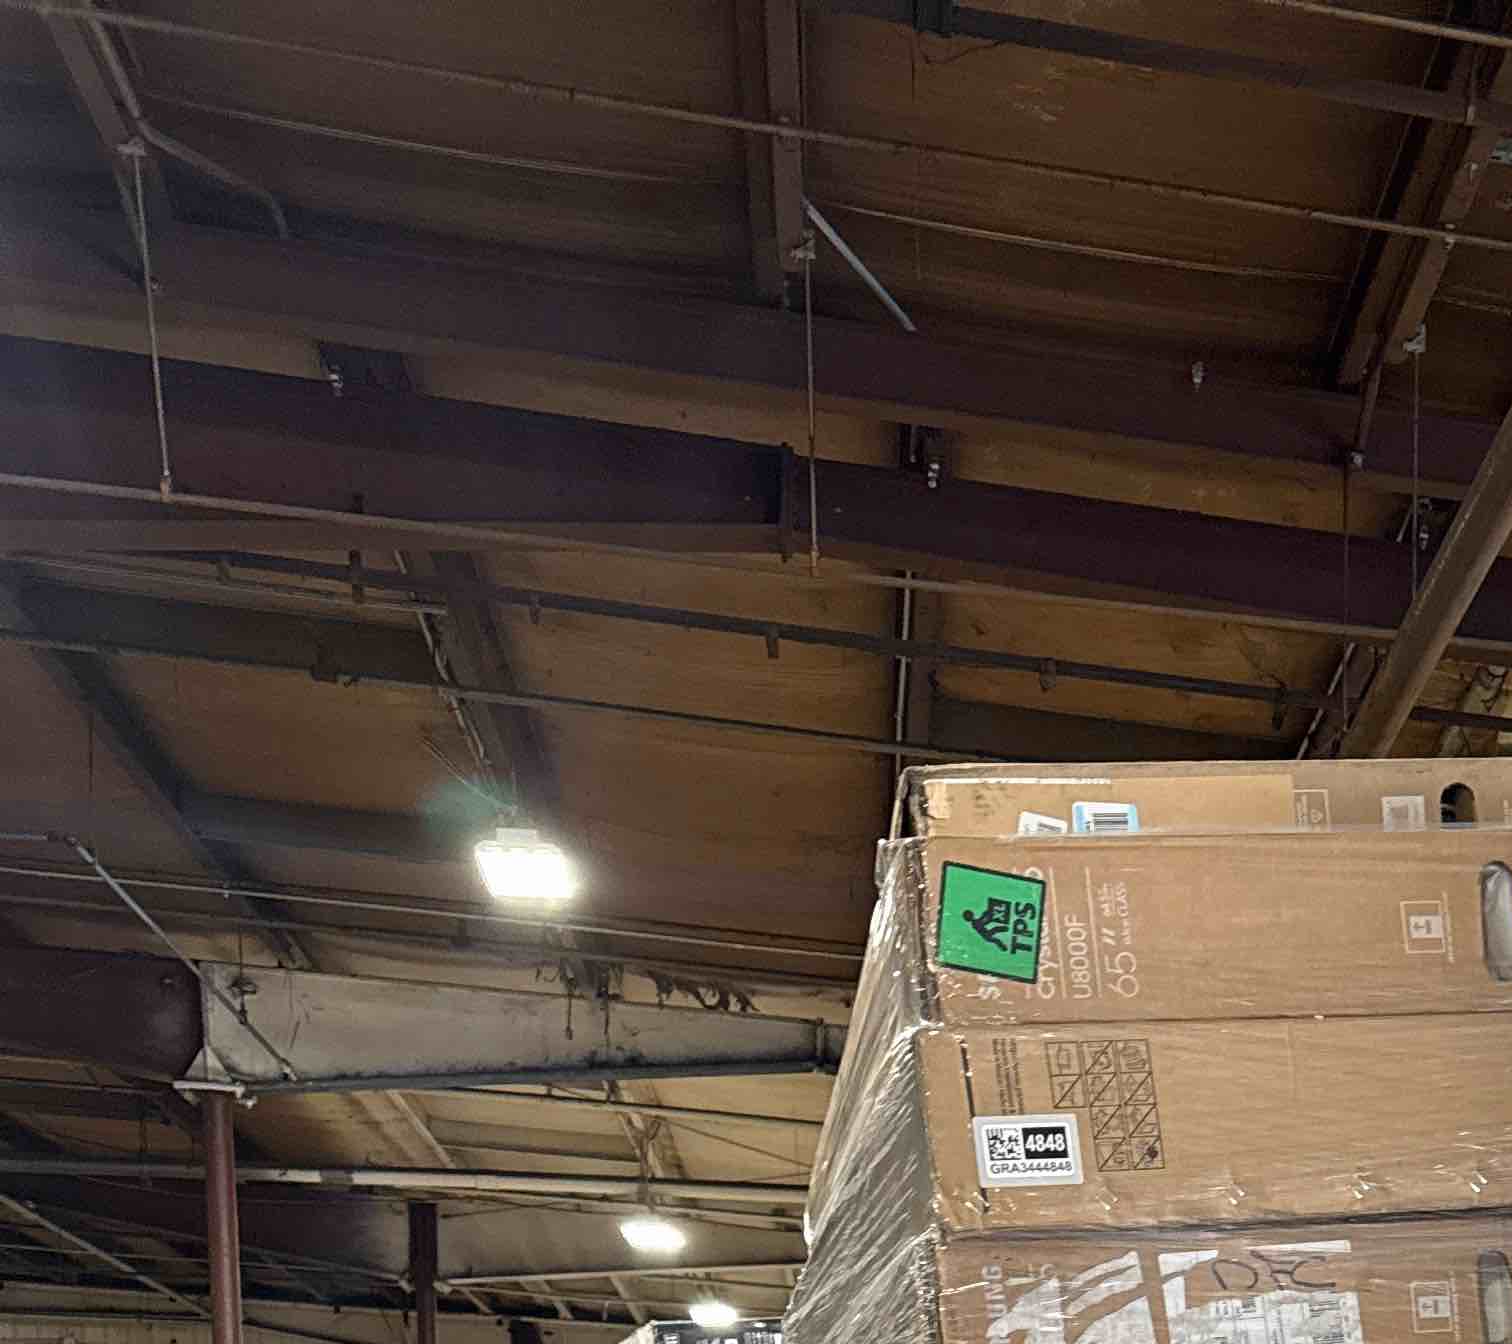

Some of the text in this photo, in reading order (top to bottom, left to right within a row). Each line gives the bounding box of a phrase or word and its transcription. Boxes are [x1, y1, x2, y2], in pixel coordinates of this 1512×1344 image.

[1009, 901, 1038, 955] TPS
[1064, 913, 1093, 1000] U8000F
[1025, 1132, 1066, 1152] 4848
[990, 1160, 1073, 1175] GRA3444848
